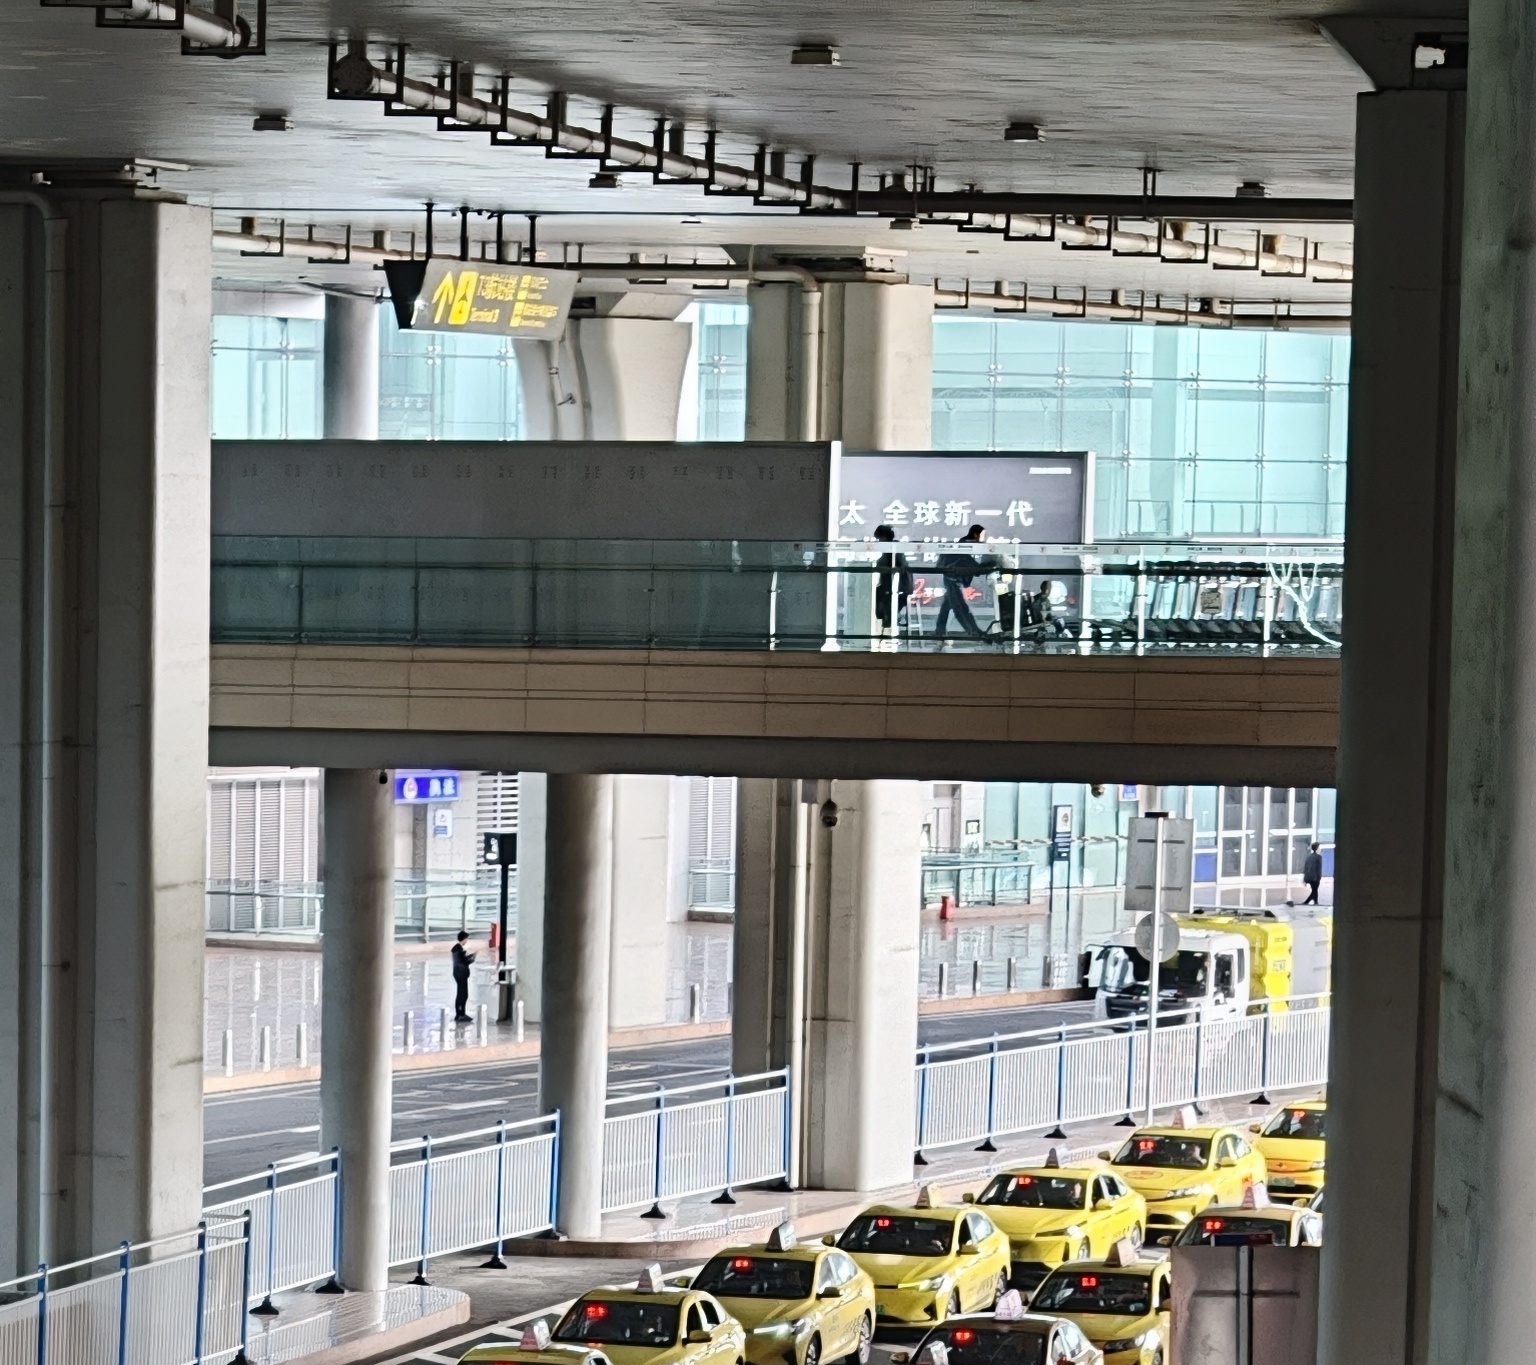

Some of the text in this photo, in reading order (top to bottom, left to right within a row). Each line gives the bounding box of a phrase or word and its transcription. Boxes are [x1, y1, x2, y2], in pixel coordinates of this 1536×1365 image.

[839, 500, 1034, 526] 太 全球新一代
